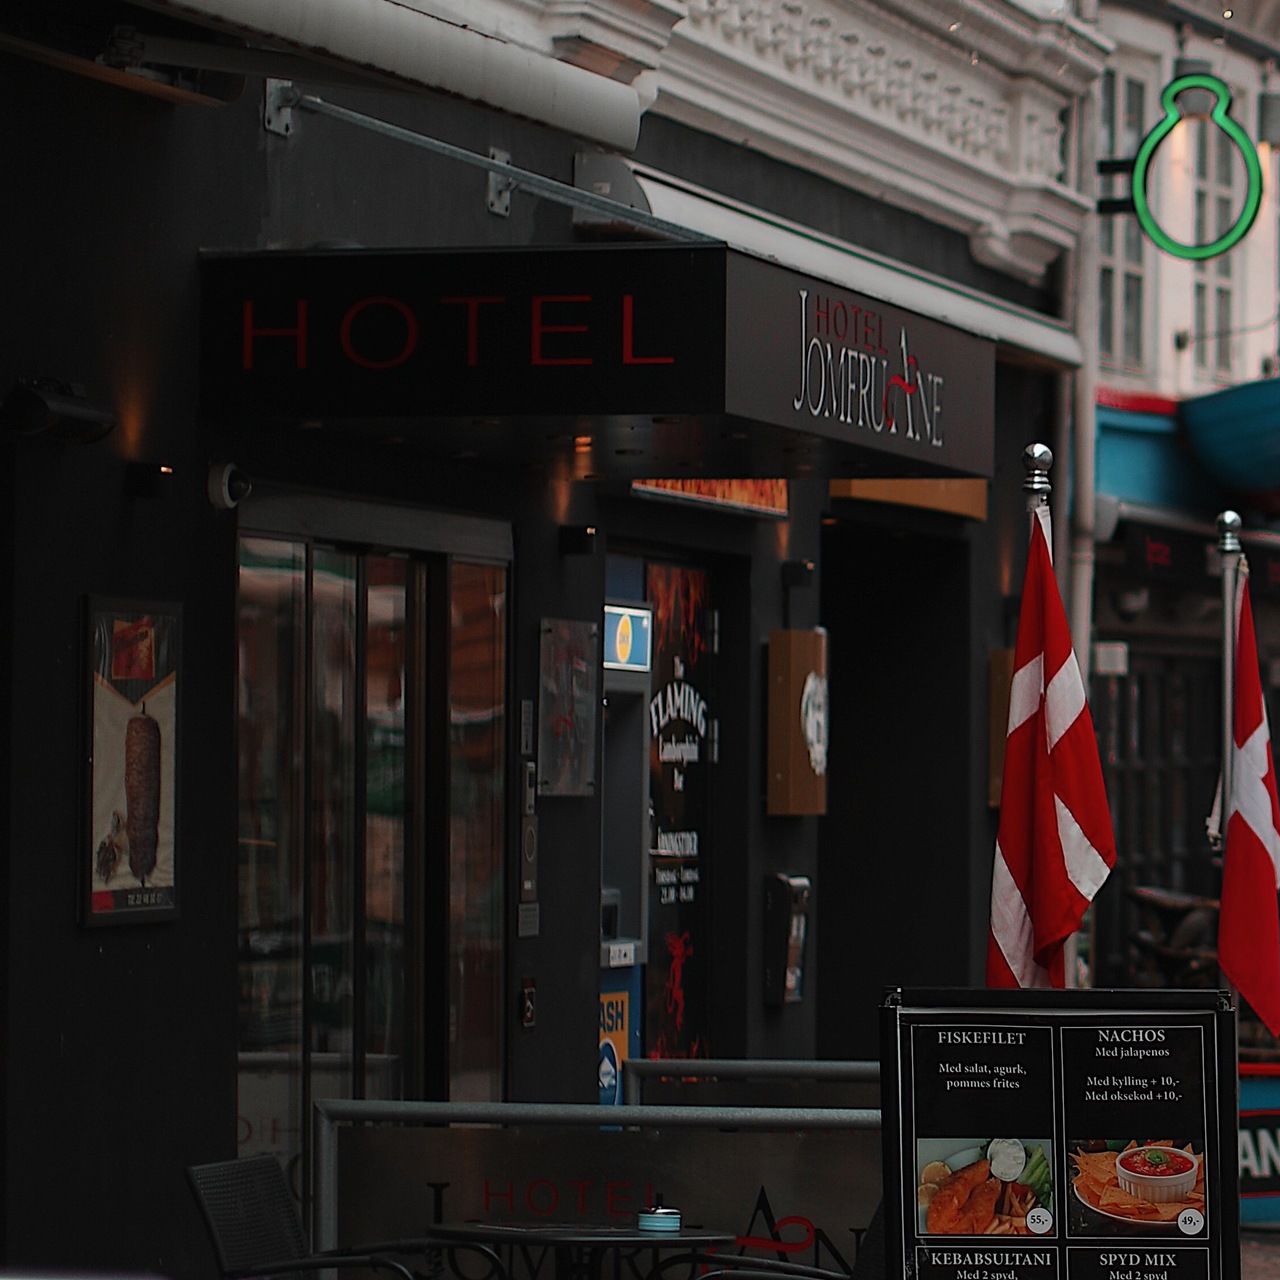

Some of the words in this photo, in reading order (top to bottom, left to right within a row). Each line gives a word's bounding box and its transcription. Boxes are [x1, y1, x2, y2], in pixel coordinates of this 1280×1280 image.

[815, 294, 888, 355] HOTEL
[242, 293, 675, 370] HOTEL
[650, 680, 707, 739] FLAMING
[599, 999, 625, 1032] ASH
[937, 1031, 1026, 1045] FISKEFILET
[1098, 1029, 1166, 1042] NACHOS
[1095, 1047, 1118, 1057] Med
[1120, 1047, 1170, 1059] jalapenos
[938, 1063, 962, 1074] Med
[964, 1063, 992, 1075] salat,
[993, 1064, 1027, 1076] agurk,
[946, 1079, 991, 1090] pommes
[993, 1078, 1020, 1089] frites
[1086, 1076, 1110, 1086] Med
[1112, 1075, 1148, 1089] kylling
[1161, 1076, 1180, 1088] 10,-
[1085, 1091, 1108, 1101] Med
[1030, 1214, 1048, 1226] 55,-
[931, 1253, 1052, 1266] KEBABSULTANI
[1099, 1253, 1141, 1266] SPYD
[1145, 1254, 1177, 1266] MIX
[956, 1270, 980, 1280] Med
[1109, 1271, 1132, 1280] Med
